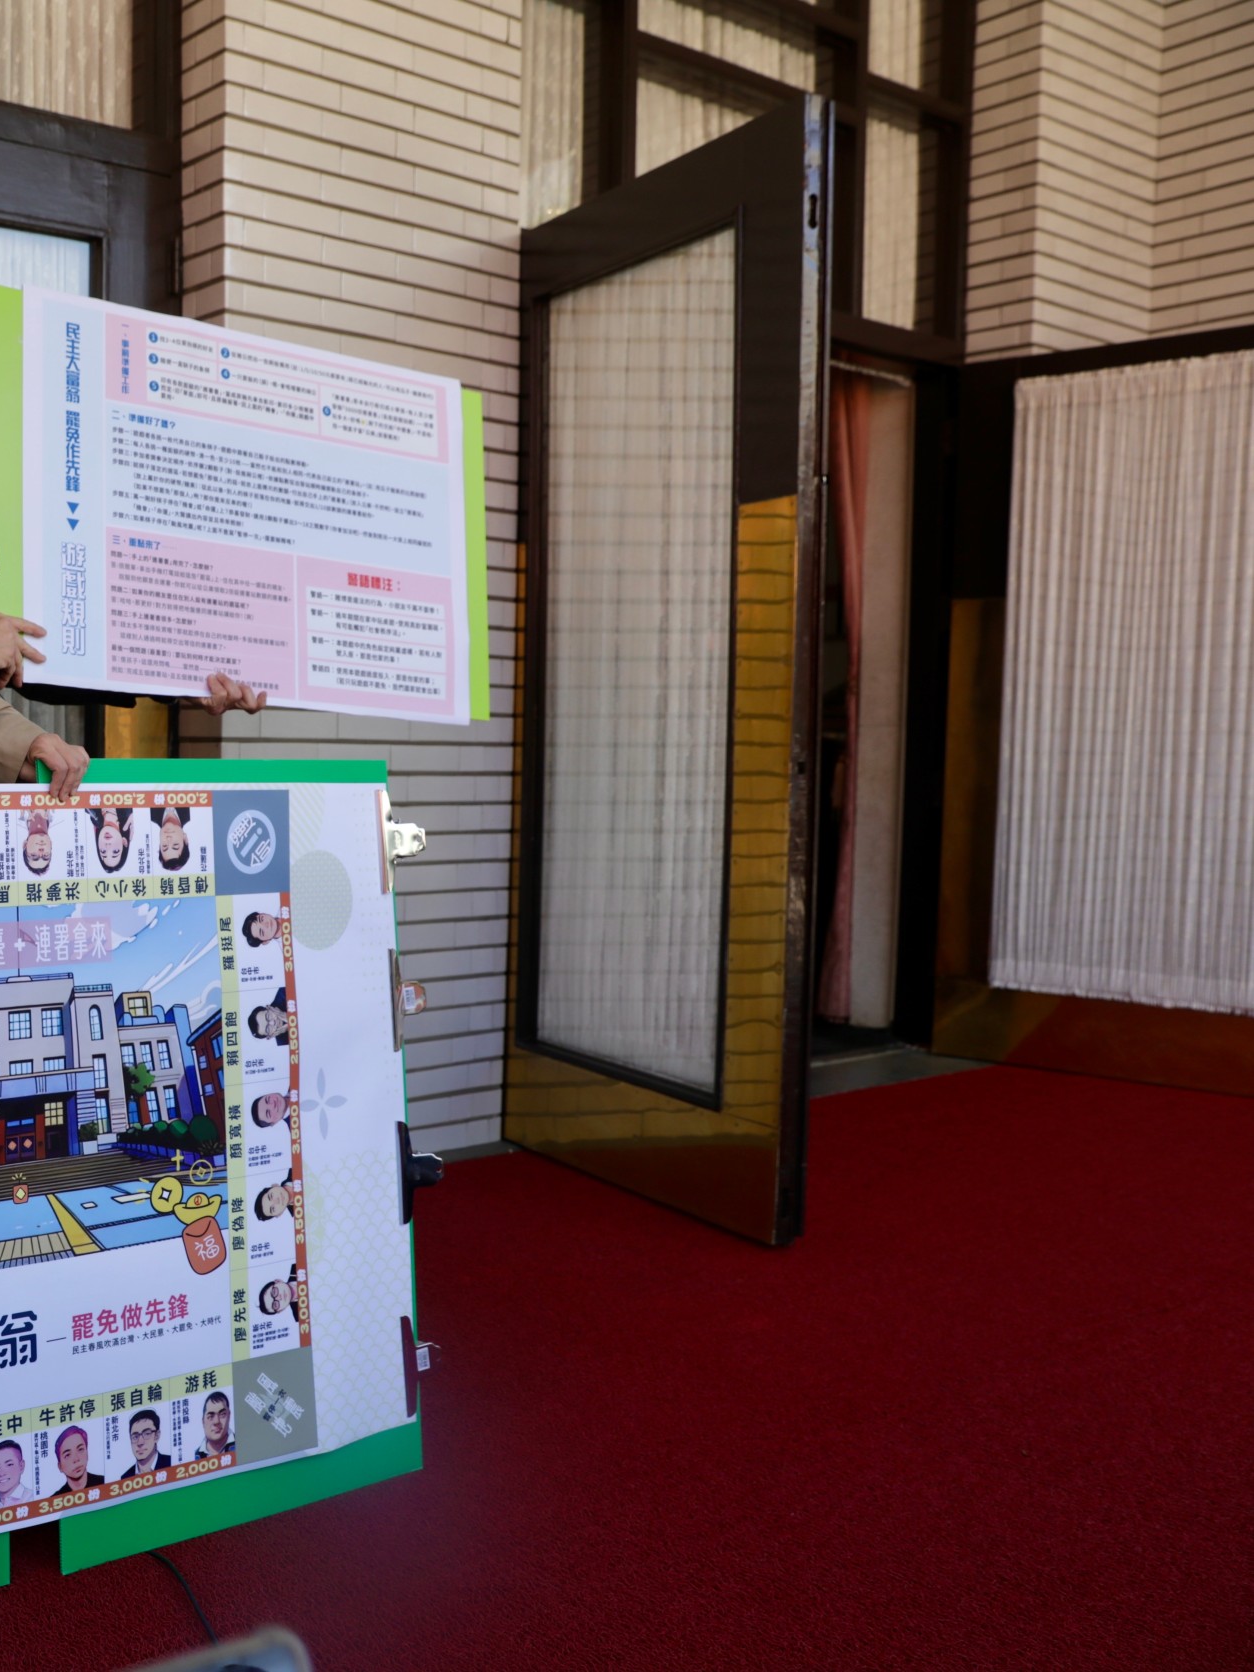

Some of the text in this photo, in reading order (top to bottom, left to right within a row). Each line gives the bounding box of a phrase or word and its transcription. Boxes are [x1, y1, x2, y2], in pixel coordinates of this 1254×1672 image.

[65, 321, 81, 493] 民主大富翁 罷免作先鋒
[61, 542, 87, 656] 遊戲規則
[95, 875, 147, 898] 徐小心
[34, 920, 108, 965] 連署拿來
[194, 1235, 221, 1262] 福
[71, 1293, 189, 1342] 罷免做先鋒
[184, 1370, 217, 1394] 游耗
[110, 1383, 163, 1412] 張自輪
[39, 1399, 96, 1428] 牛許停
